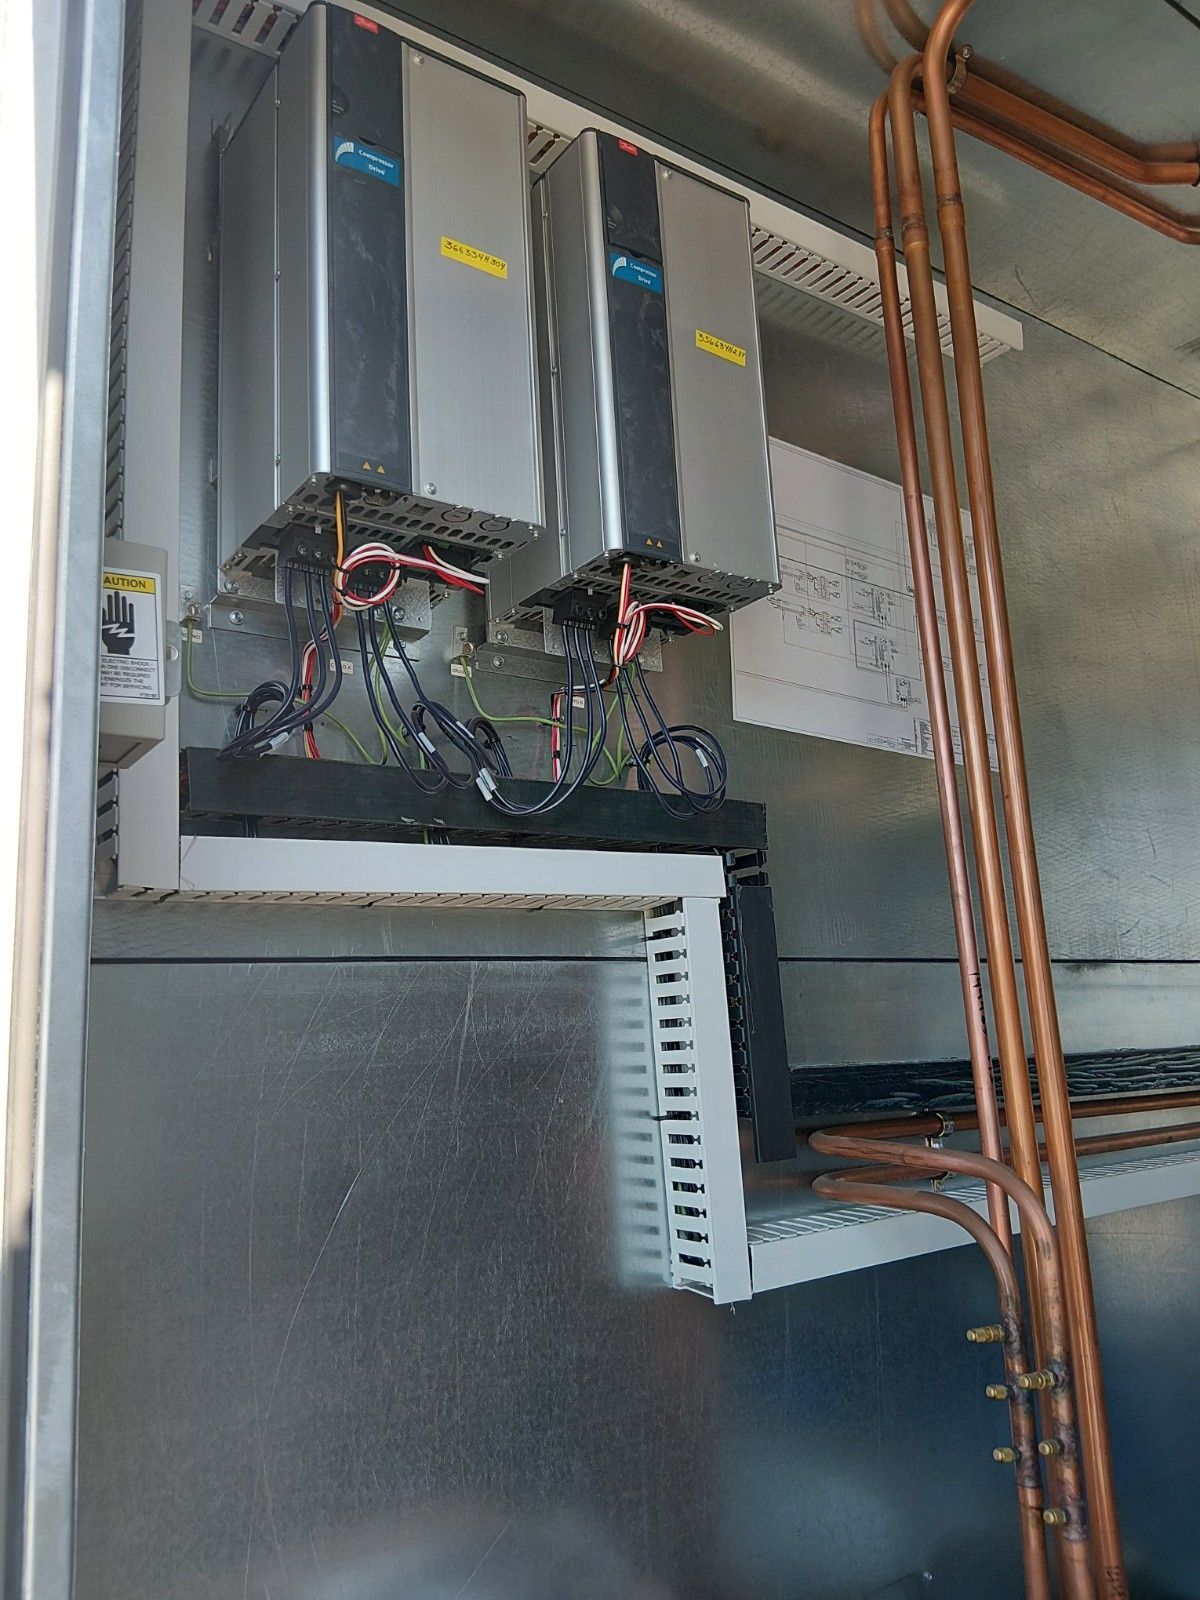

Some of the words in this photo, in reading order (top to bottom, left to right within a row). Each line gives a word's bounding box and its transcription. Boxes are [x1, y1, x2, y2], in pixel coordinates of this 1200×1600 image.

[359, 149, 394, 169] Compressor
[368, 163, 386, 176] Drive
[103, 575, 146, 589] AUTION
